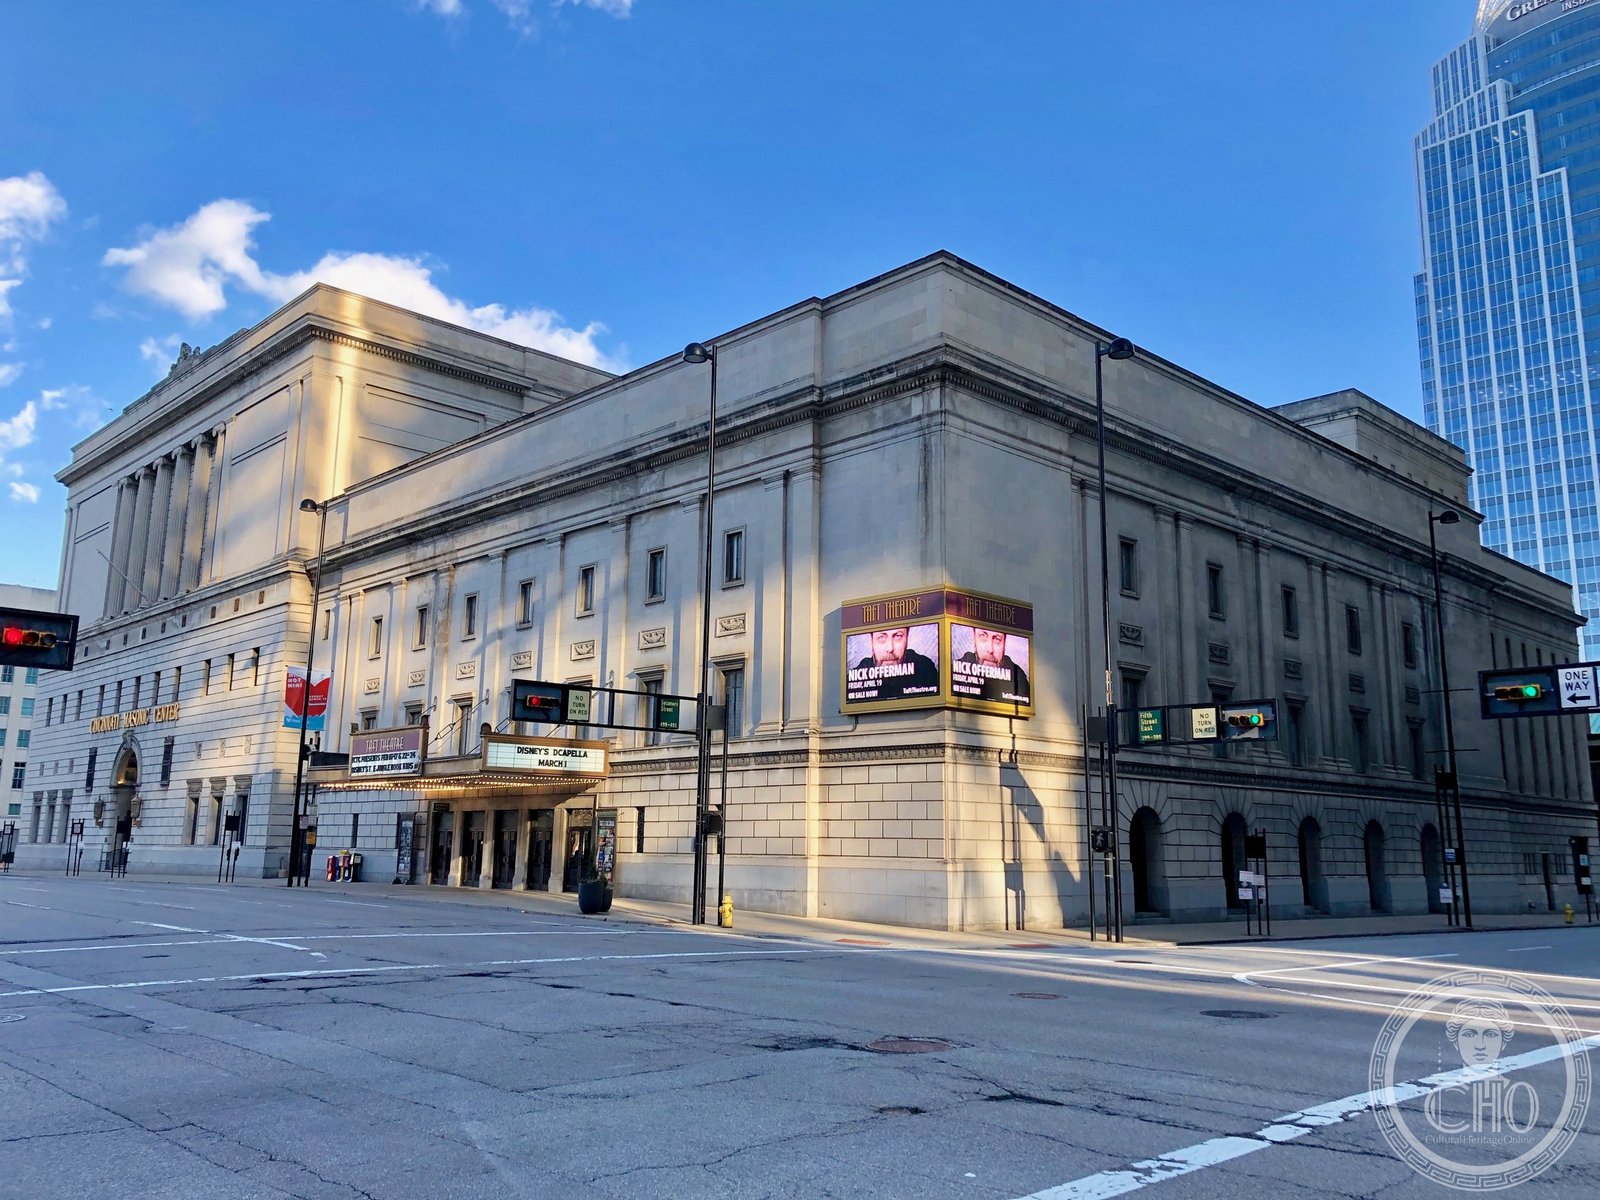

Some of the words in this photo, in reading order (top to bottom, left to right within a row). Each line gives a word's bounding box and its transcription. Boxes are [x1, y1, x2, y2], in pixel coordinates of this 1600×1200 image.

[863, 604, 880, 622] TAFT
[884, 597, 921, 619] THEATRE
[965, 598, 982, 617] TAFT
[984, 601, 1015, 624] THEATRE
[848, 667, 868, 682] NICK
[868, 662, 915, 679] OFFERMAN
[953, 660, 971, 675] NICK
[971, 664, 1011, 681] OFFERMAN
[1565, 671, 1589, 681] ONE
[848, 681, 864, 689] FRIDAY,
[864, 680, 876, 688] APRIL
[876, 679, 883, 687] 19
[978, 677, 985, 686] 19
[1565, 681, 1589, 691] WAY
[855, 691, 866, 699] SALE
[866, 690, 878, 698] NOW!
[959, 685, 970, 693] SALE
[123, 708, 150, 728] MASONIC
[153, 703, 180, 723] CENTER
[365, 740, 378, 752] TAFT
[379, 737, 404, 751] THEATRE
[517, 746, 550, 756] DISNEY'S
[553, 748, 588, 758] DCAPELLA
[538, 758, 563, 768] MARCH
